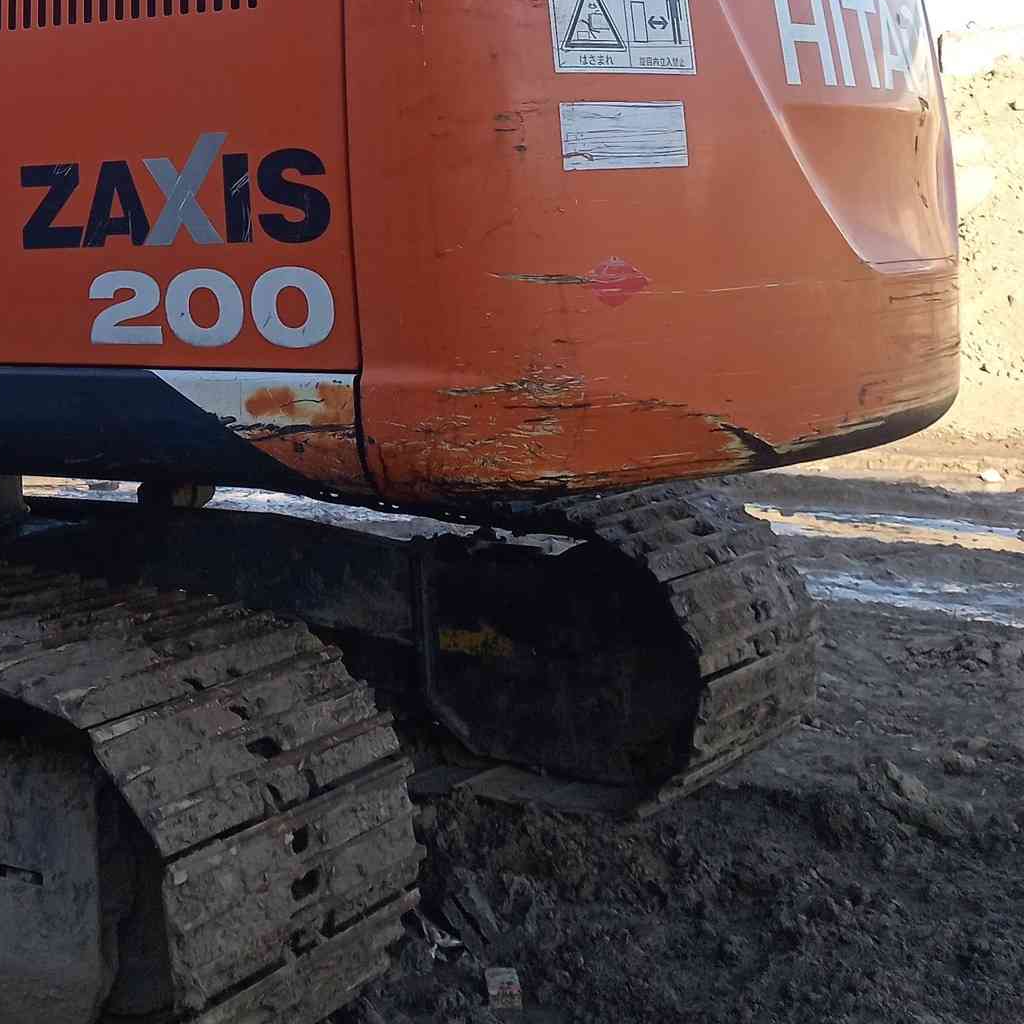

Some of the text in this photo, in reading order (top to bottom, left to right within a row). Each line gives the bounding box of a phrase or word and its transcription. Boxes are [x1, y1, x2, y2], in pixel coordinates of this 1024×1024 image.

[579, 54, 615, 66] はさまれ
[20, 131, 332, 250] ZAXIS
[88, 266, 336, 349] 200
